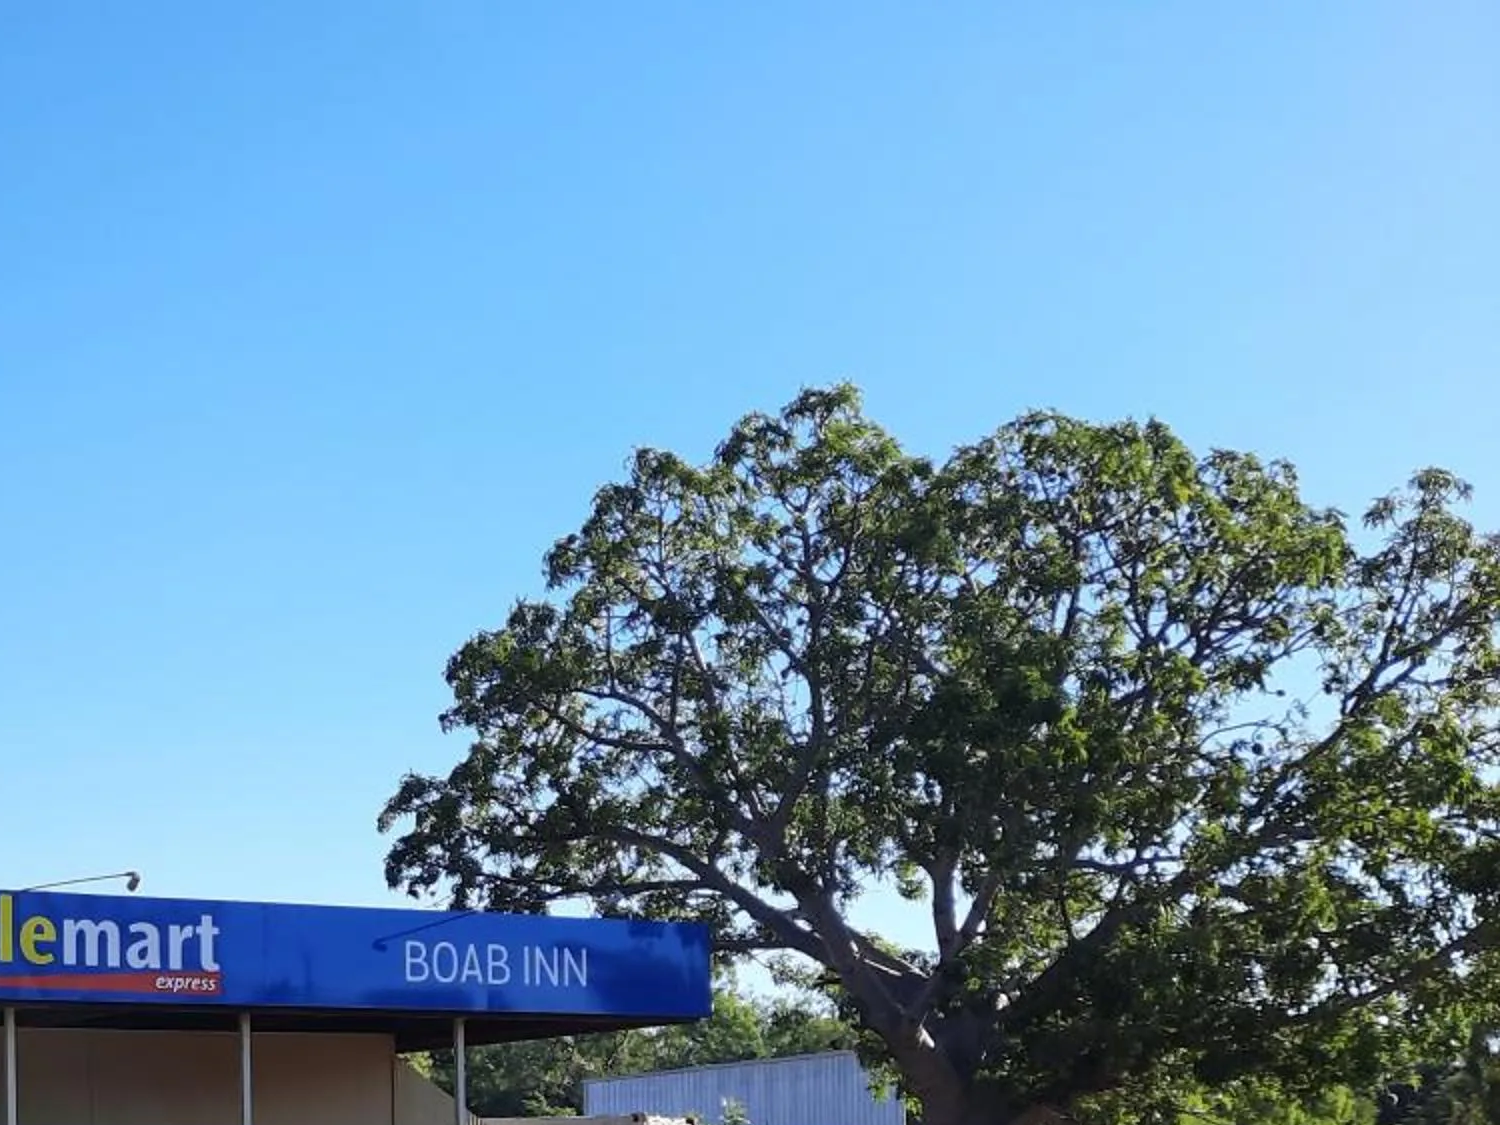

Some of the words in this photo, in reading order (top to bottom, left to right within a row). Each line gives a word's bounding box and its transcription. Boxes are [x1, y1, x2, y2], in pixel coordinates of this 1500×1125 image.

[404, 941, 511, 986] BOAB
[522, 946, 588, 988] INN
[155, 976, 217, 992] express
